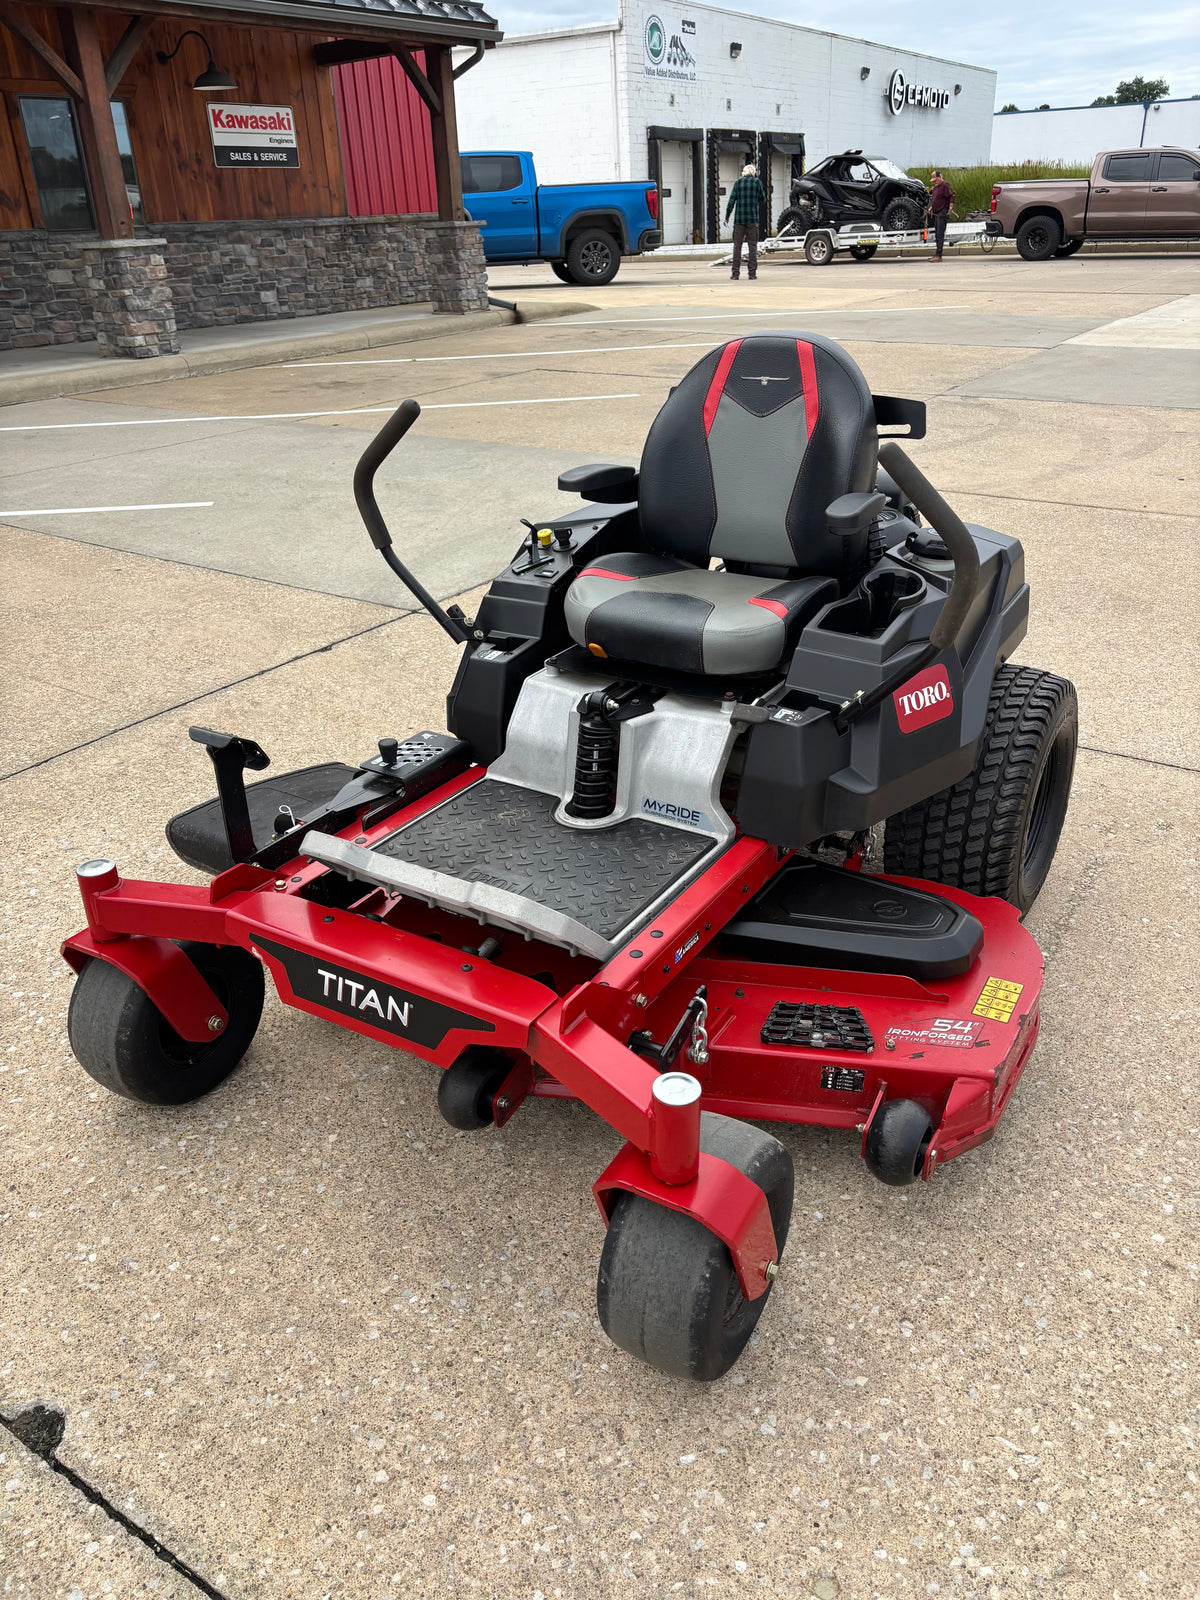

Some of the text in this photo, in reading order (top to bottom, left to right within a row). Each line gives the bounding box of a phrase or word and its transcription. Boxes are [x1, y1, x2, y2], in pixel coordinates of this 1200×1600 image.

[645, 66, 656, 77] Value
[656, 68, 668, 78] Added
[906, 84, 951, 109] CFMOTO
[211, 108, 292, 131] Kawasaki
[230, 152, 288, 162] SALES & SERVICE
[898, 681, 947, 716] TORO
[643, 798, 701, 822] MYRIDE
[645, 809, 697, 826] SUSPENSION SYSTEM
[317, 968, 410, 1028] TITAN
[884, 1034, 926, 1043] CUTTING
